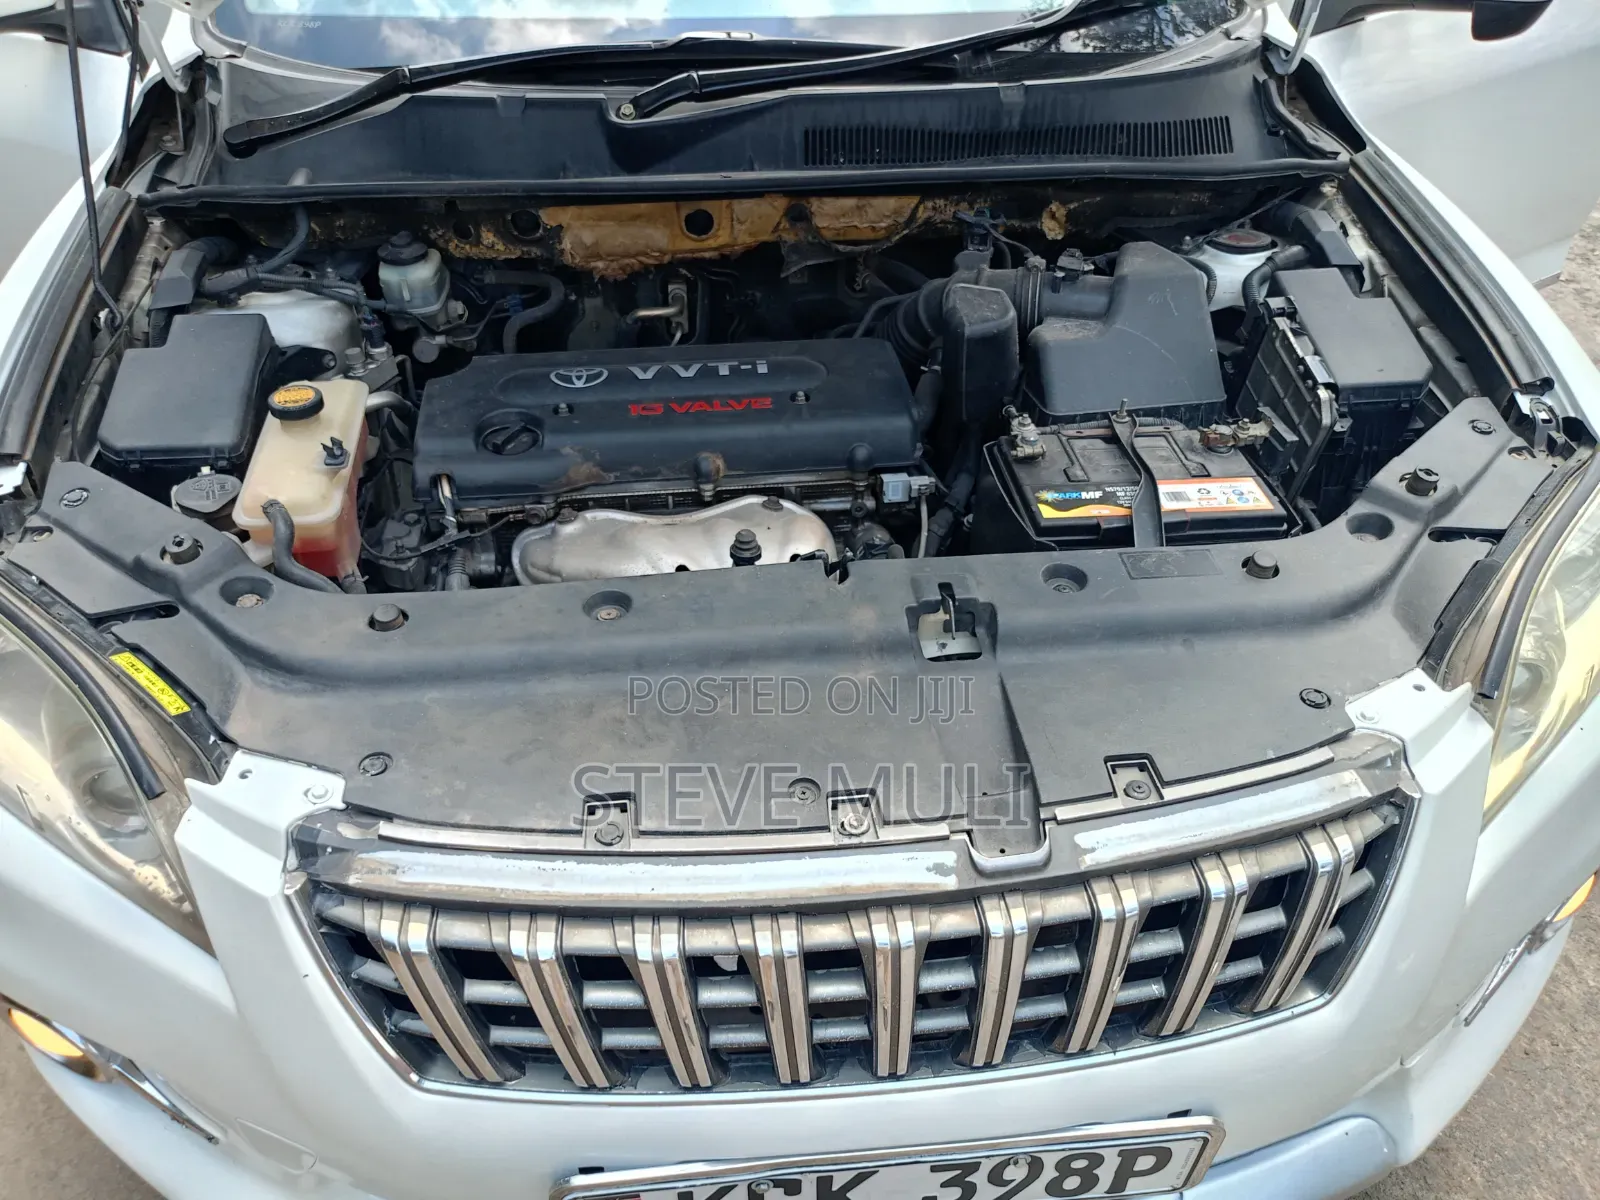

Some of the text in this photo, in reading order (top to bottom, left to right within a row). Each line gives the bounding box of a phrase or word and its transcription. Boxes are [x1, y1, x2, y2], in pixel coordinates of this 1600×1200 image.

[627, 360, 769, 380] VVT-i
[628, 397, 773, 416] 16 VALVE
[921, 1145, 1173, 1200] 398P
